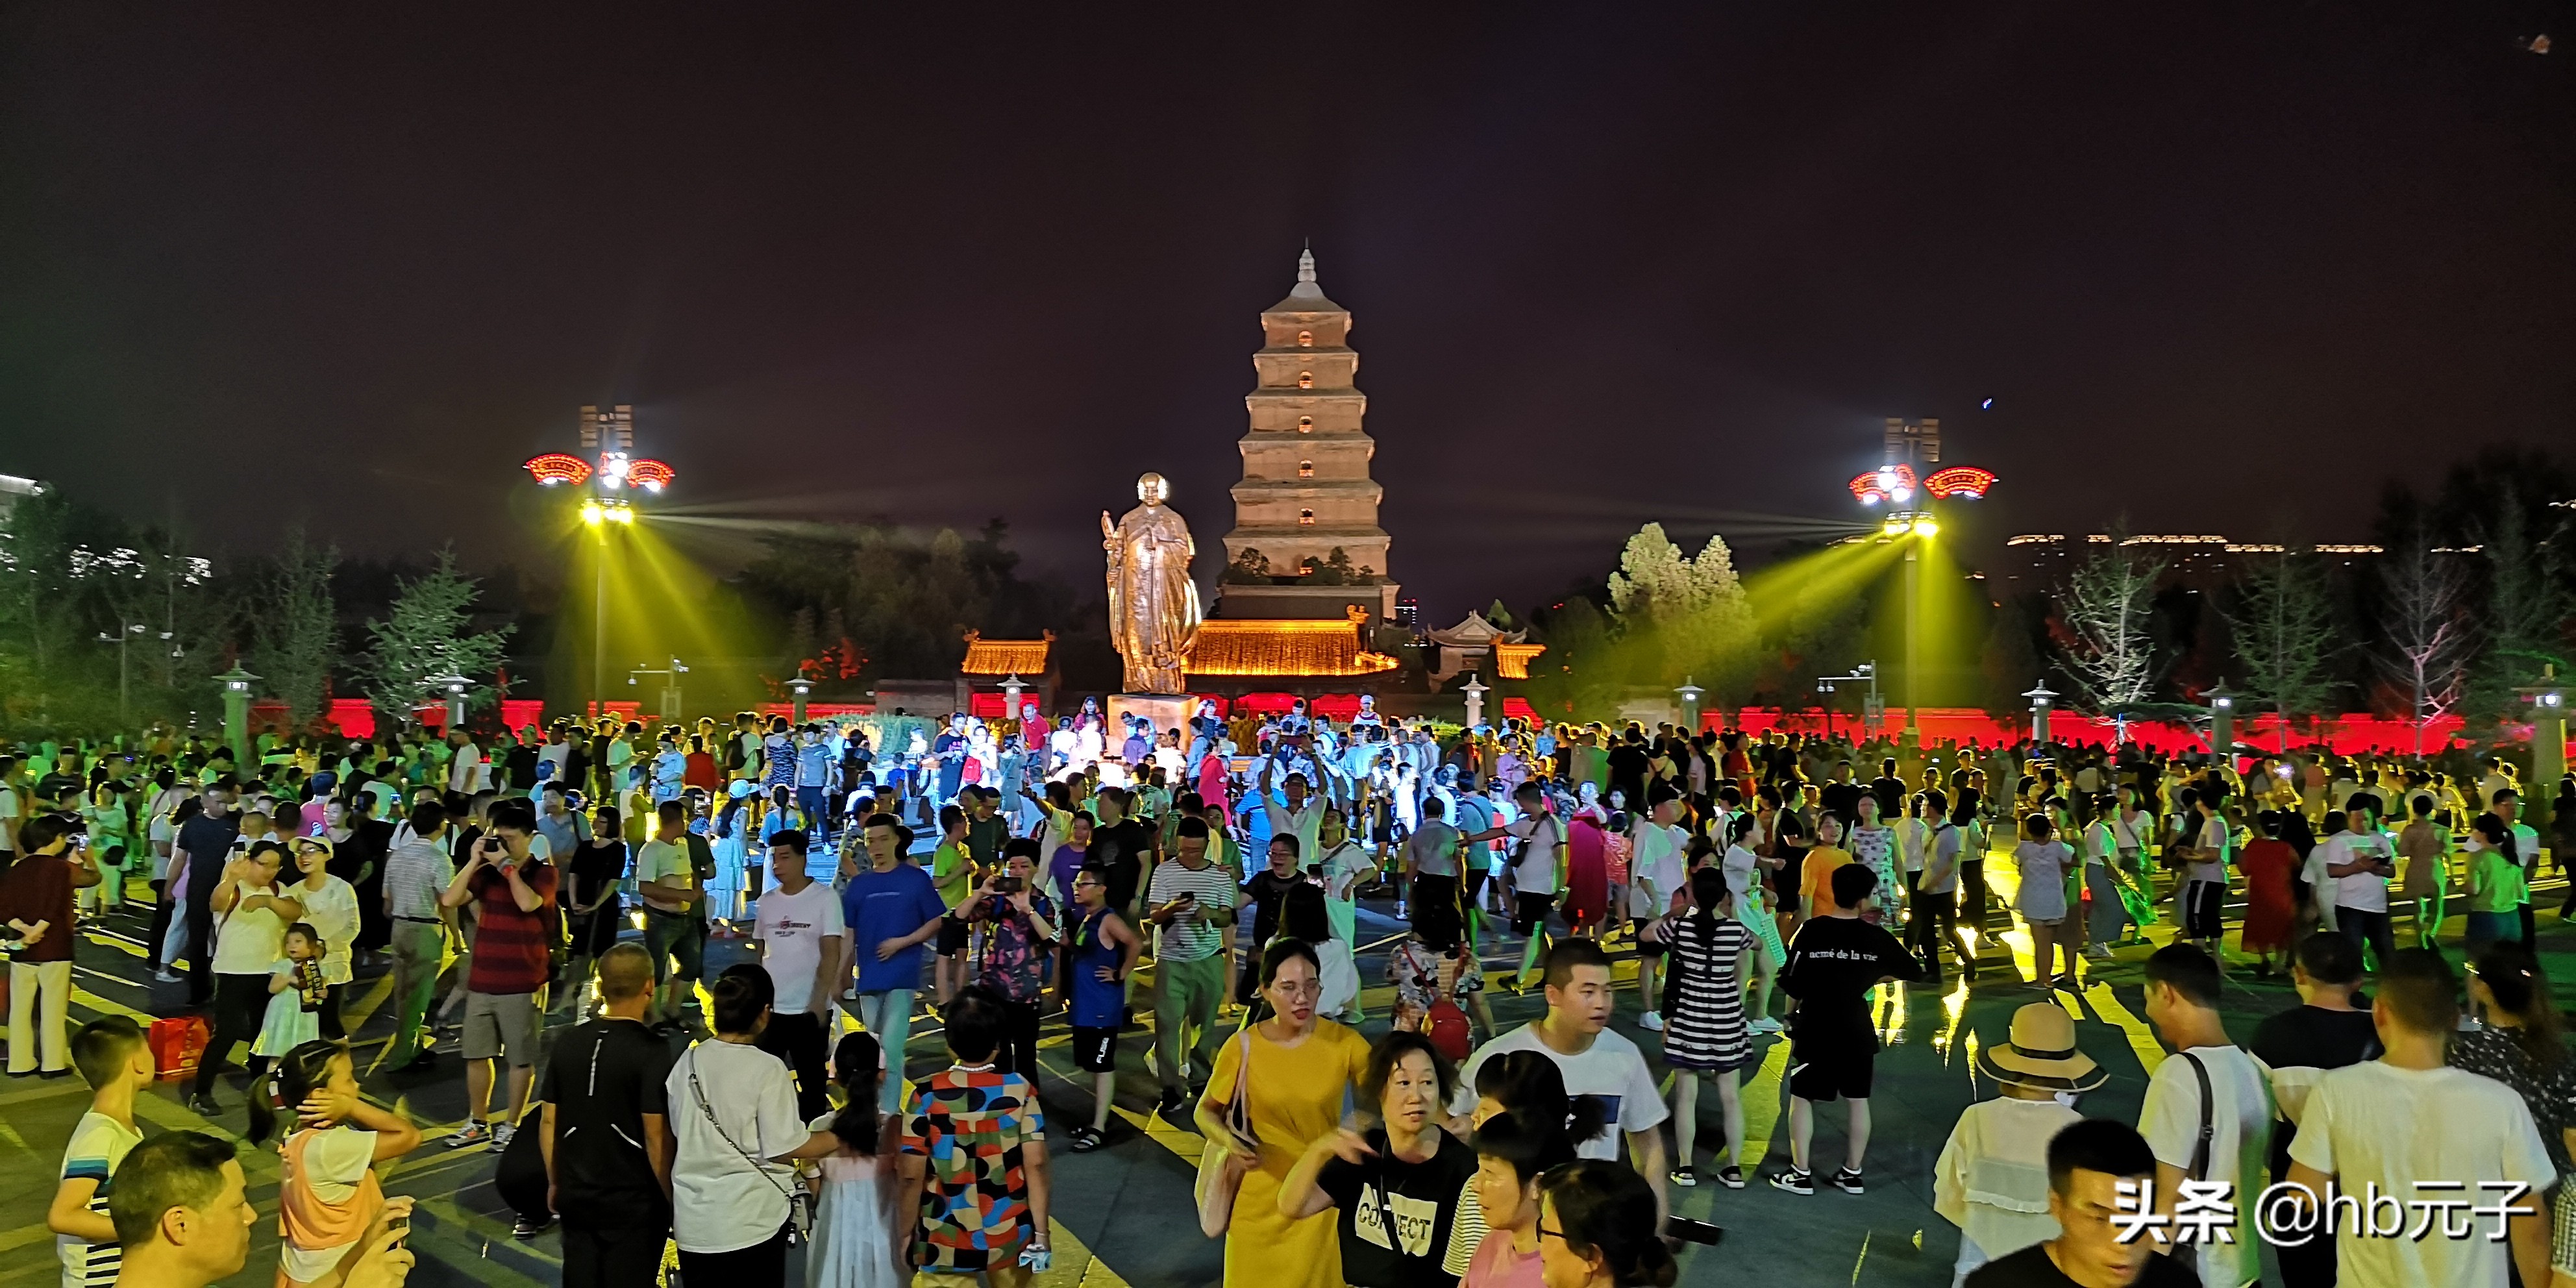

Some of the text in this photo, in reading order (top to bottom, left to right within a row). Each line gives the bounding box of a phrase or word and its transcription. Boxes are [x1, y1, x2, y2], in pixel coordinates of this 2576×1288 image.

[1836, 949, 1849, 960] de
[1850, 949, 1861, 960] la
[1863, 952, 1878, 961] vie
[1357, 1202, 1431, 1240] COECT
